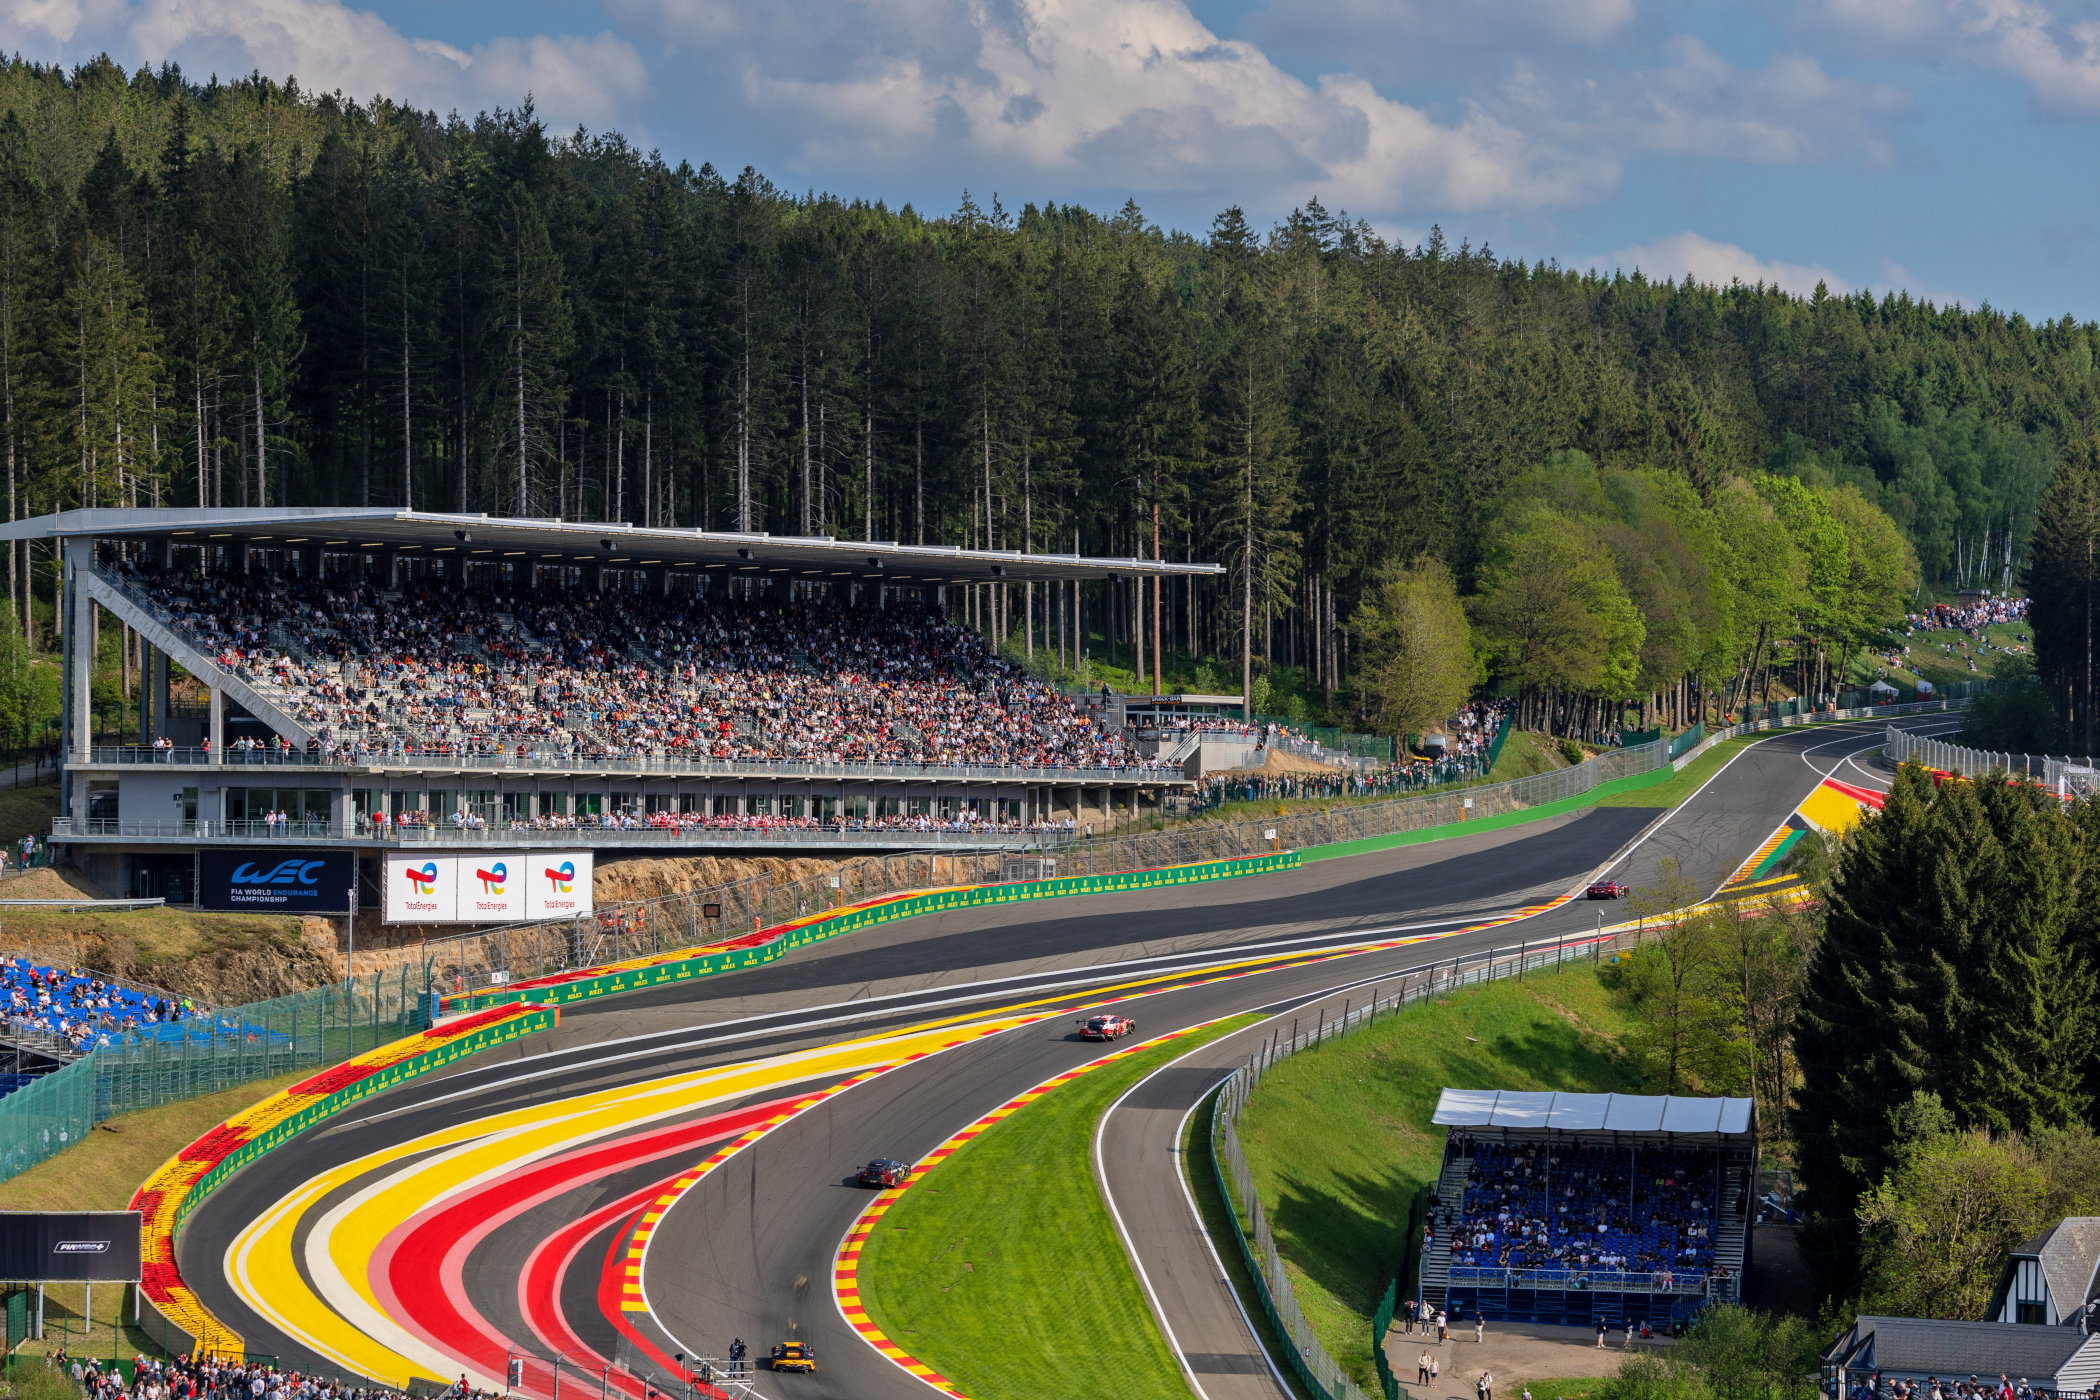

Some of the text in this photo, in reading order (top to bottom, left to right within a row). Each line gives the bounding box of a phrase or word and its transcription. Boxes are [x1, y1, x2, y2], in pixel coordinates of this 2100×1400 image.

[231, 859, 325, 885] WEC
[405, 902, 437, 912] TotalEnergies
[476, 902, 508, 912] TotalEnergies
[544, 900, 575, 910] TotalEnergies
[744, 958, 758, 966] ROLEX
[656, 974, 670, 982] ROLEX
[588, 988, 604, 996] ROLEX
[610, 984, 624, 992] ROLEX
